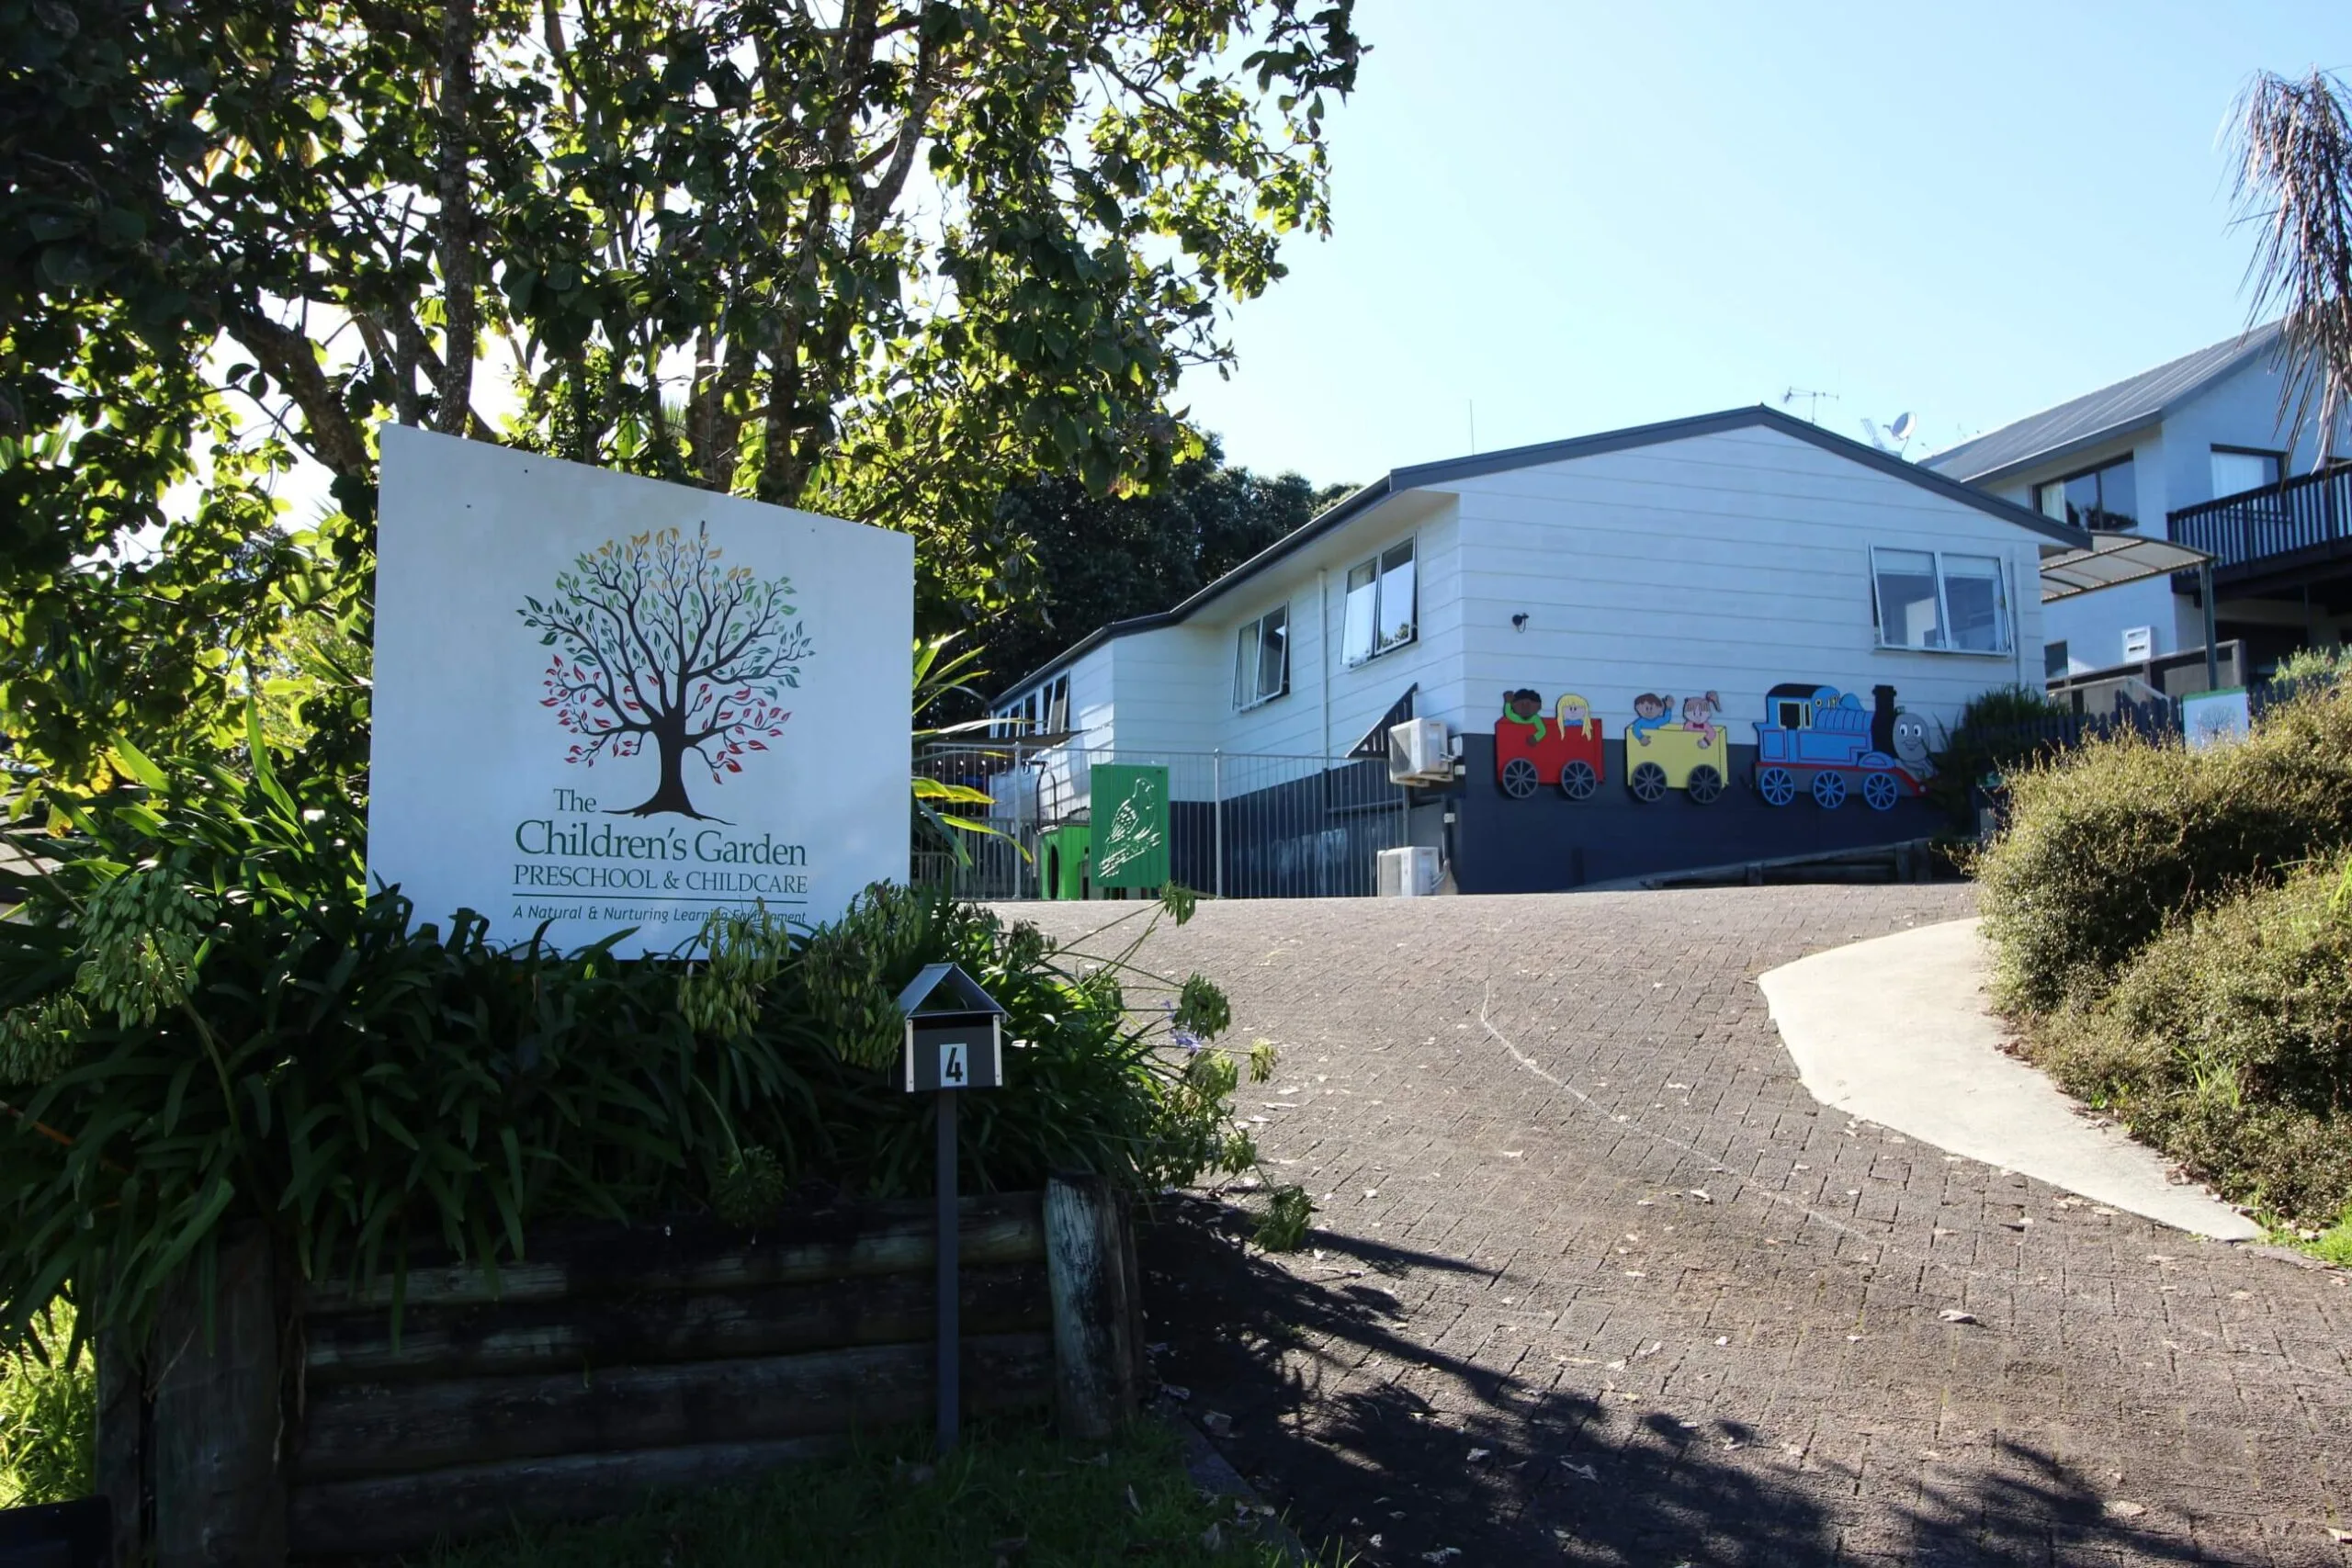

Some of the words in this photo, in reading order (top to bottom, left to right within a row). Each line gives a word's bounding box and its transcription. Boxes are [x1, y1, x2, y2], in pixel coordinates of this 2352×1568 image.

[553, 788, 597, 813] The
[515, 819, 687, 860] Children's
[695, 829, 807, 866] Garden
[513, 864, 658, 889] PRESCHOOL
[663, 870, 680, 890] &
[686, 872, 808, 894] CHILDCARE
[513, 905, 523, 919] A
[528, 905, 582, 919] Natural
[587, 906, 597, 919] &
[604, 907, 669, 924] Nurturing
[673, 908, 729, 924] Learnig
[945, 1047, 964, 1083] 4
